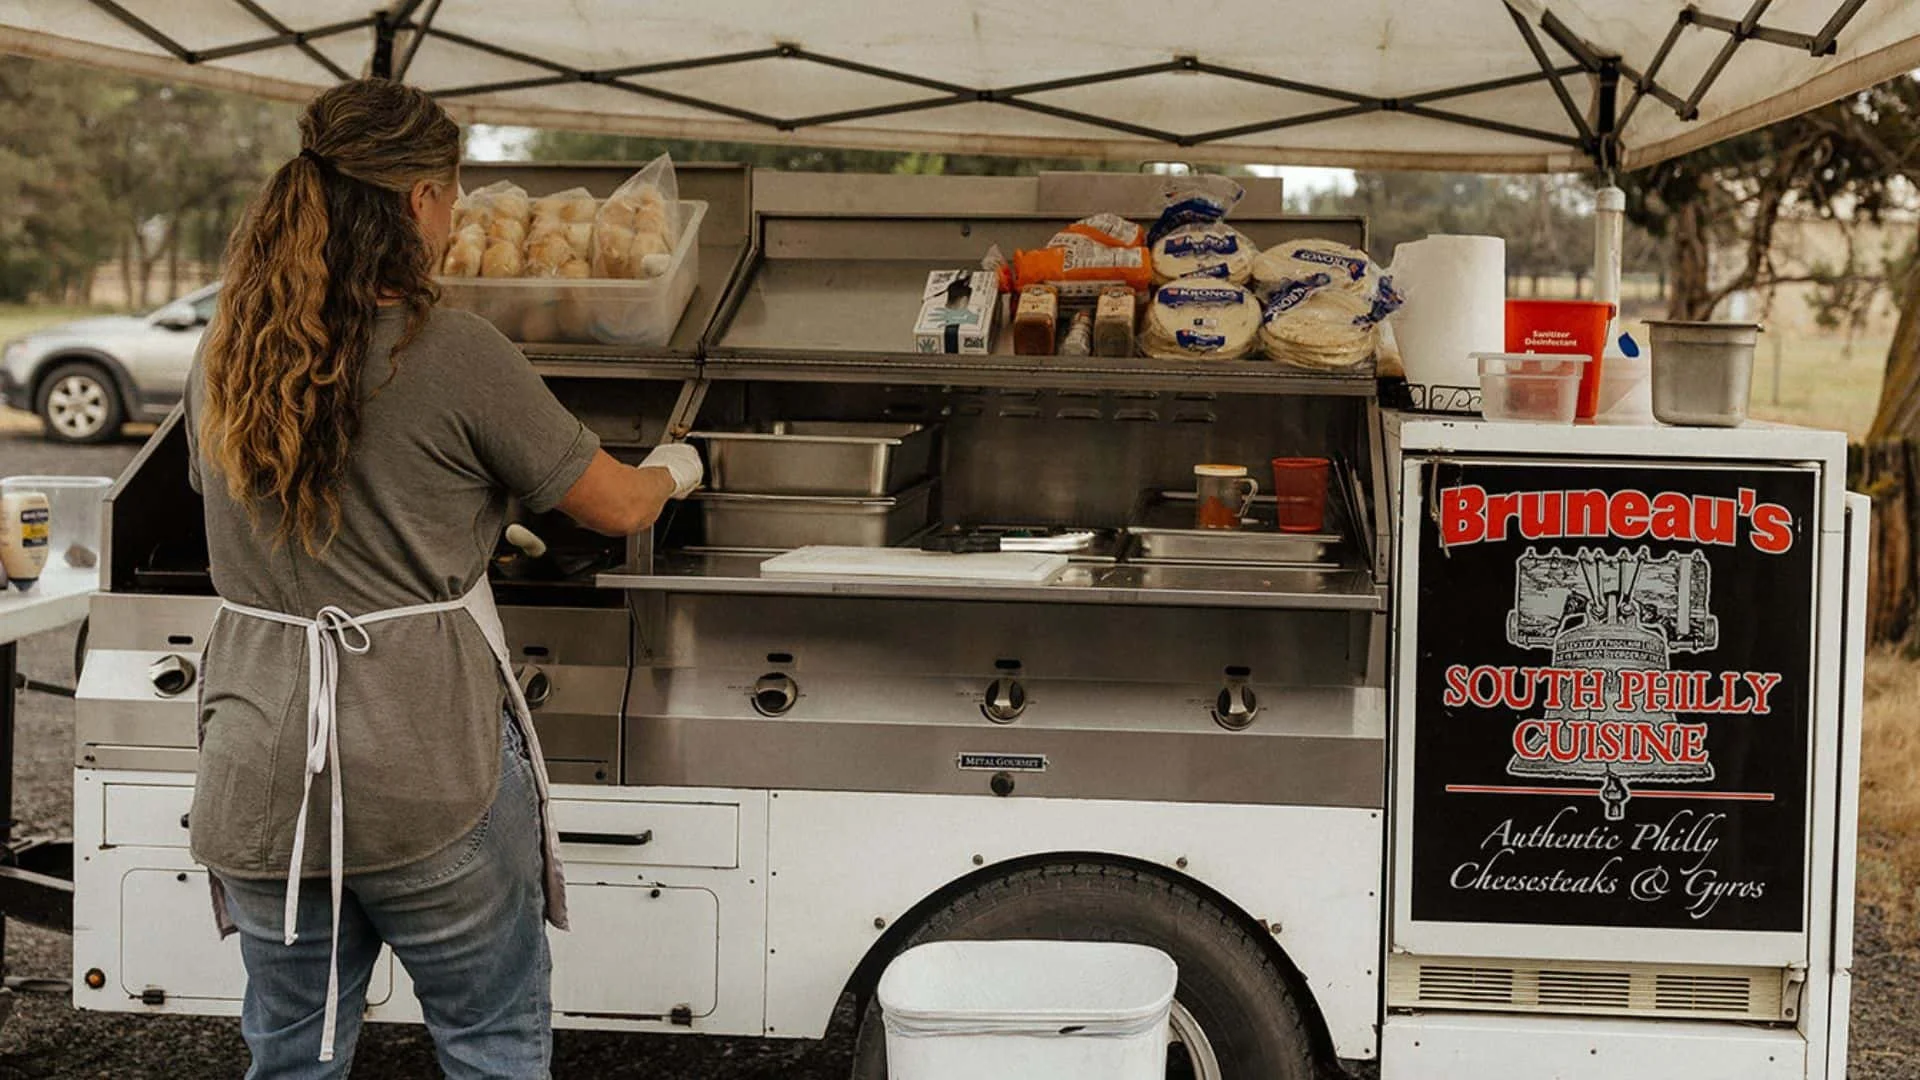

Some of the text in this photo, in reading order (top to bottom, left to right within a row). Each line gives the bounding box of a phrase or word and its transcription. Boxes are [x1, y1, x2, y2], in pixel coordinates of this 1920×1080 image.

[1180, 288, 1238, 299] KRONOS
[1532, 330, 1571, 339] Sanitizer
[1439, 484, 1793, 554] Bruneau's
[1444, 665, 1782, 714] SOUTH PHILLY
[1513, 719, 1709, 764] CUISINE
[1480, 806, 1727, 875] Authentic Philly
[1450, 848, 1766, 919] Cheesesteaks & Gyros
